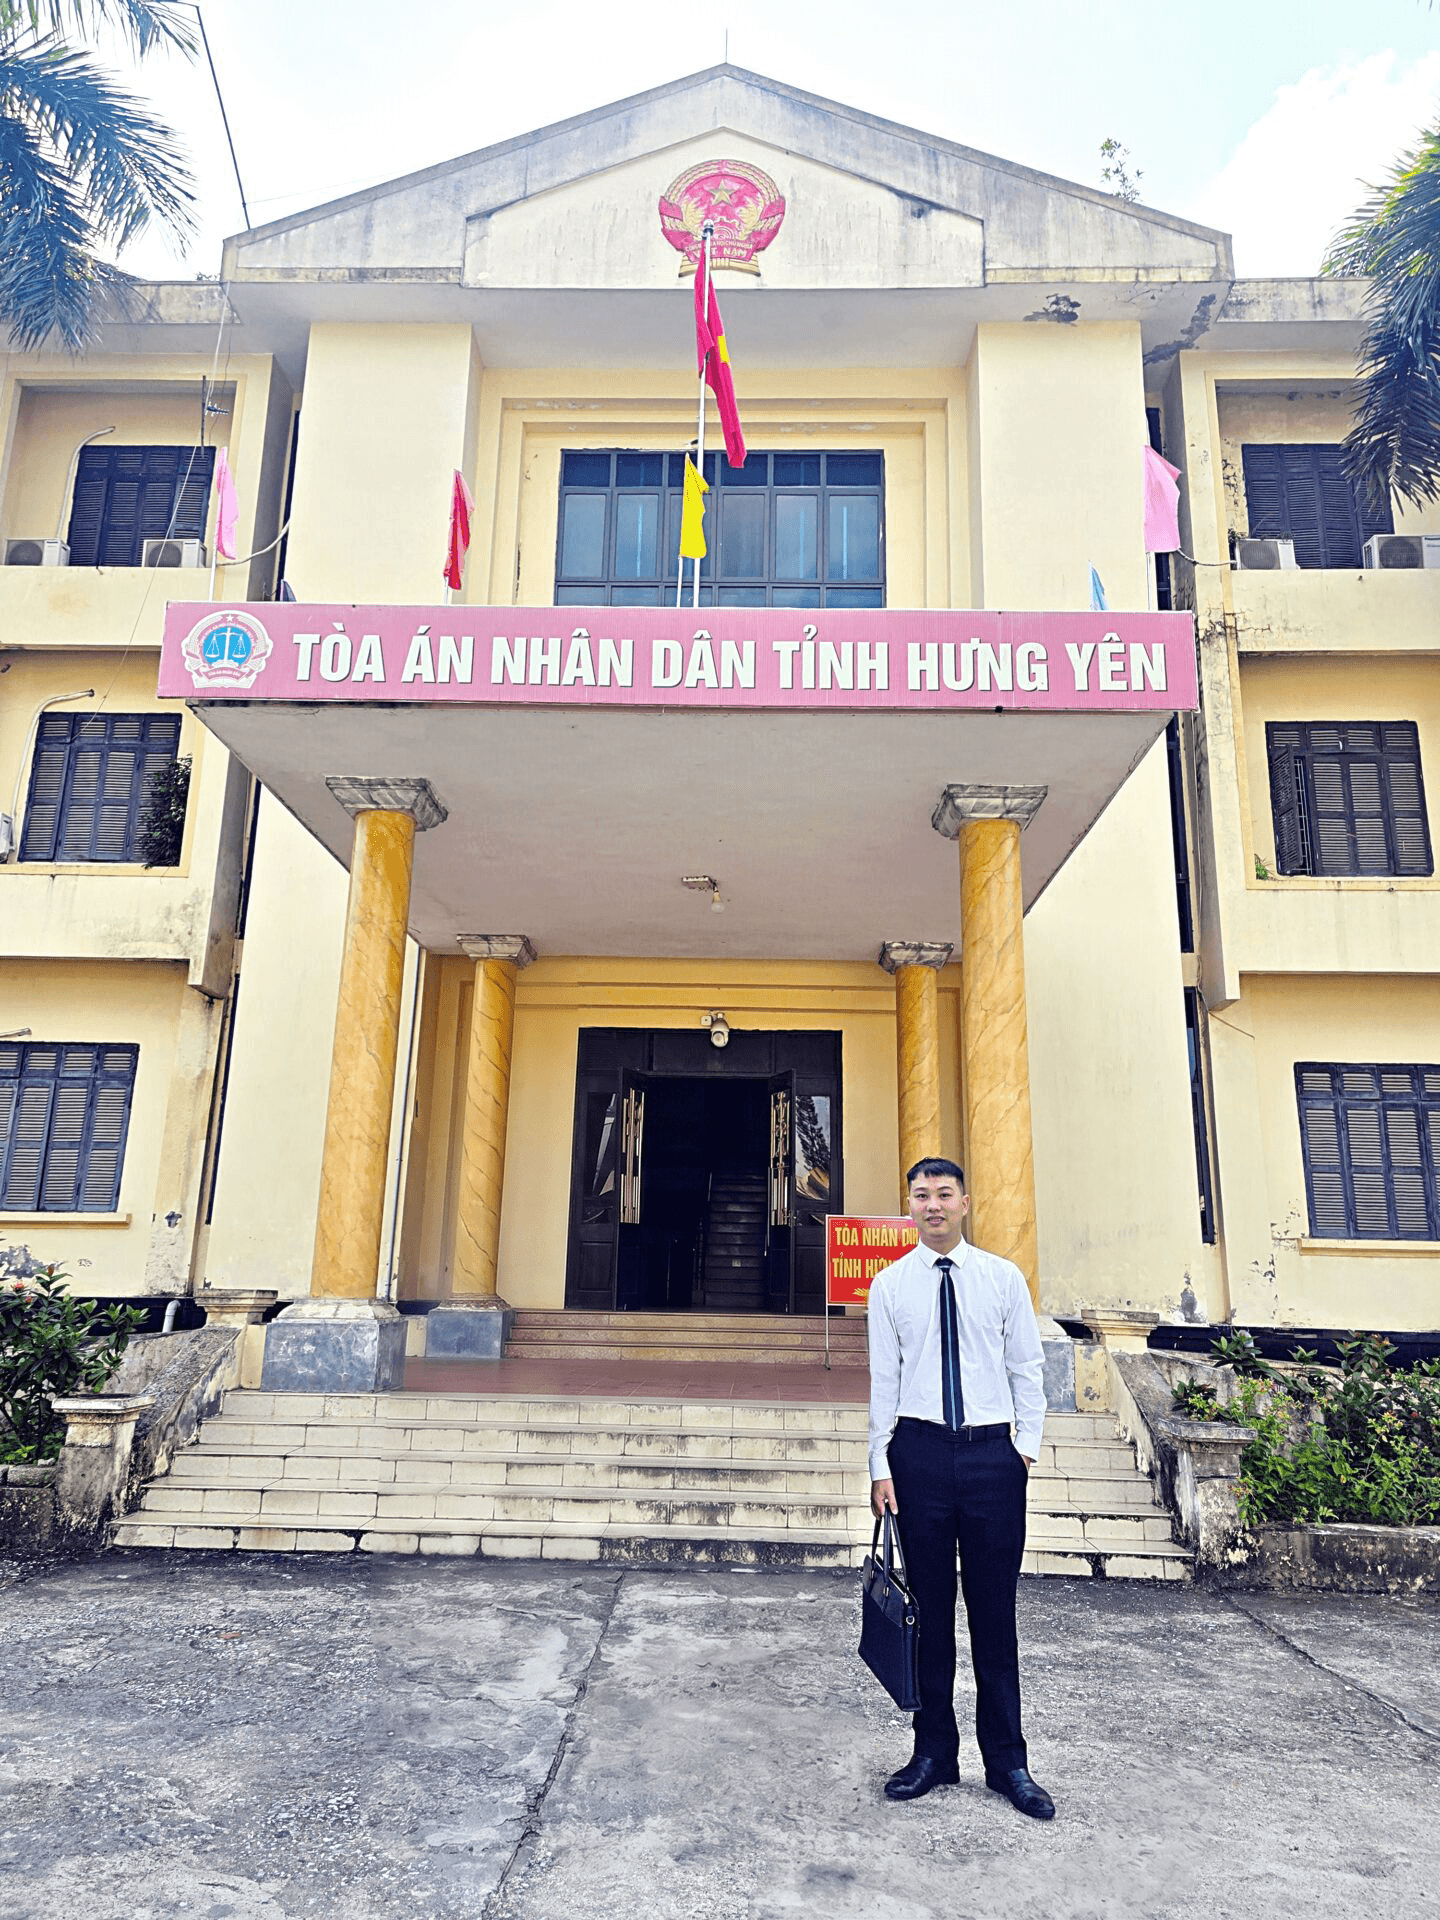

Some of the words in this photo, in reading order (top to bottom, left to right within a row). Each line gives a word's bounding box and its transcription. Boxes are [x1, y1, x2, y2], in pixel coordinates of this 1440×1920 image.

[293, 623, 385, 683] TÒA
[401, 626, 475, 684] ÁN
[491, 628, 634, 687] NHÂN
[652, 630, 756, 689] DÂN
[773, 625, 889, 690] TỈNH
[908, 638, 1048, 692] HƯNG
[1065, 633, 1168, 692] YÊN
[835, 1223, 859, 1246] TÒA
[862, 1225, 898, 1247] NHÂN
[832, 1252, 862, 1278] TỈNH
